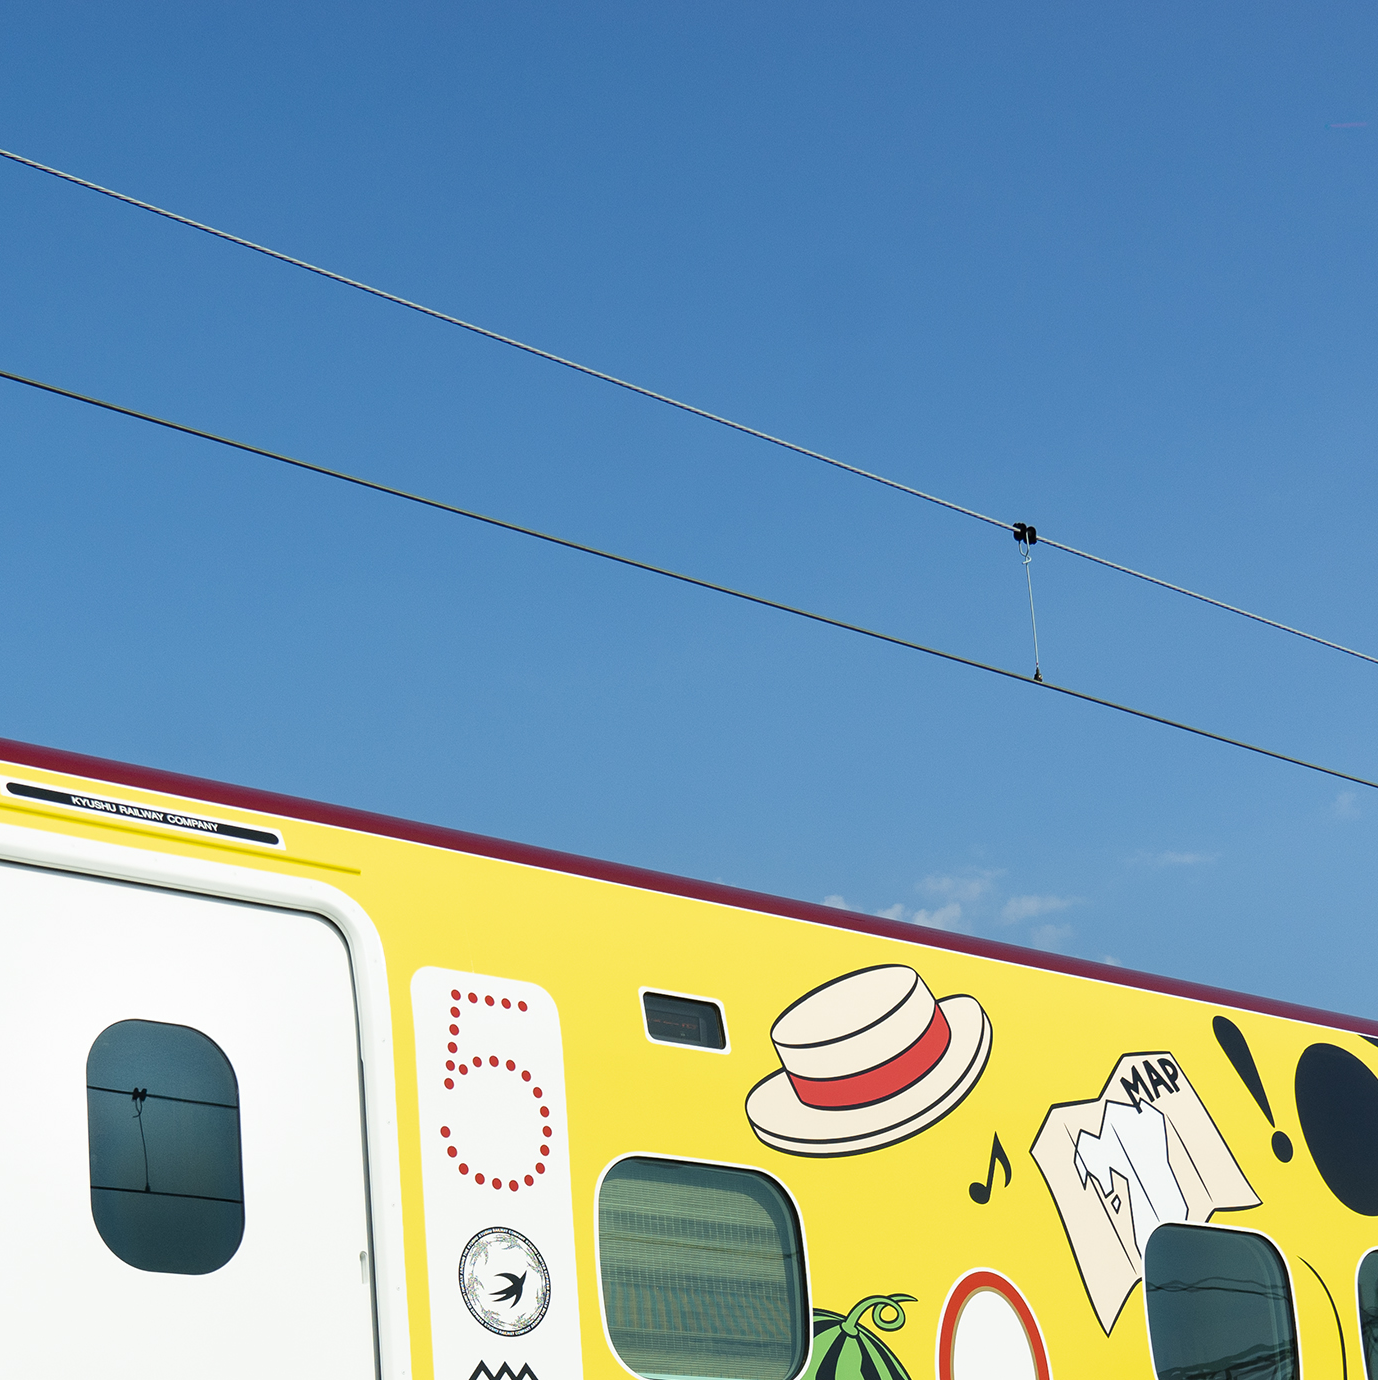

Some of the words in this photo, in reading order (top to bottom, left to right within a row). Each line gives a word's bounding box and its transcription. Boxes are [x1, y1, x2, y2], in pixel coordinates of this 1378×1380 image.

[71, 796, 117, 813] KYUSHU
[119, 804, 164, 823] RAILWAY
[167, 814, 219, 833] COMPANY
[441, 989, 552, 1192] 5
[1119, 1058, 1181, 1114] MAP
